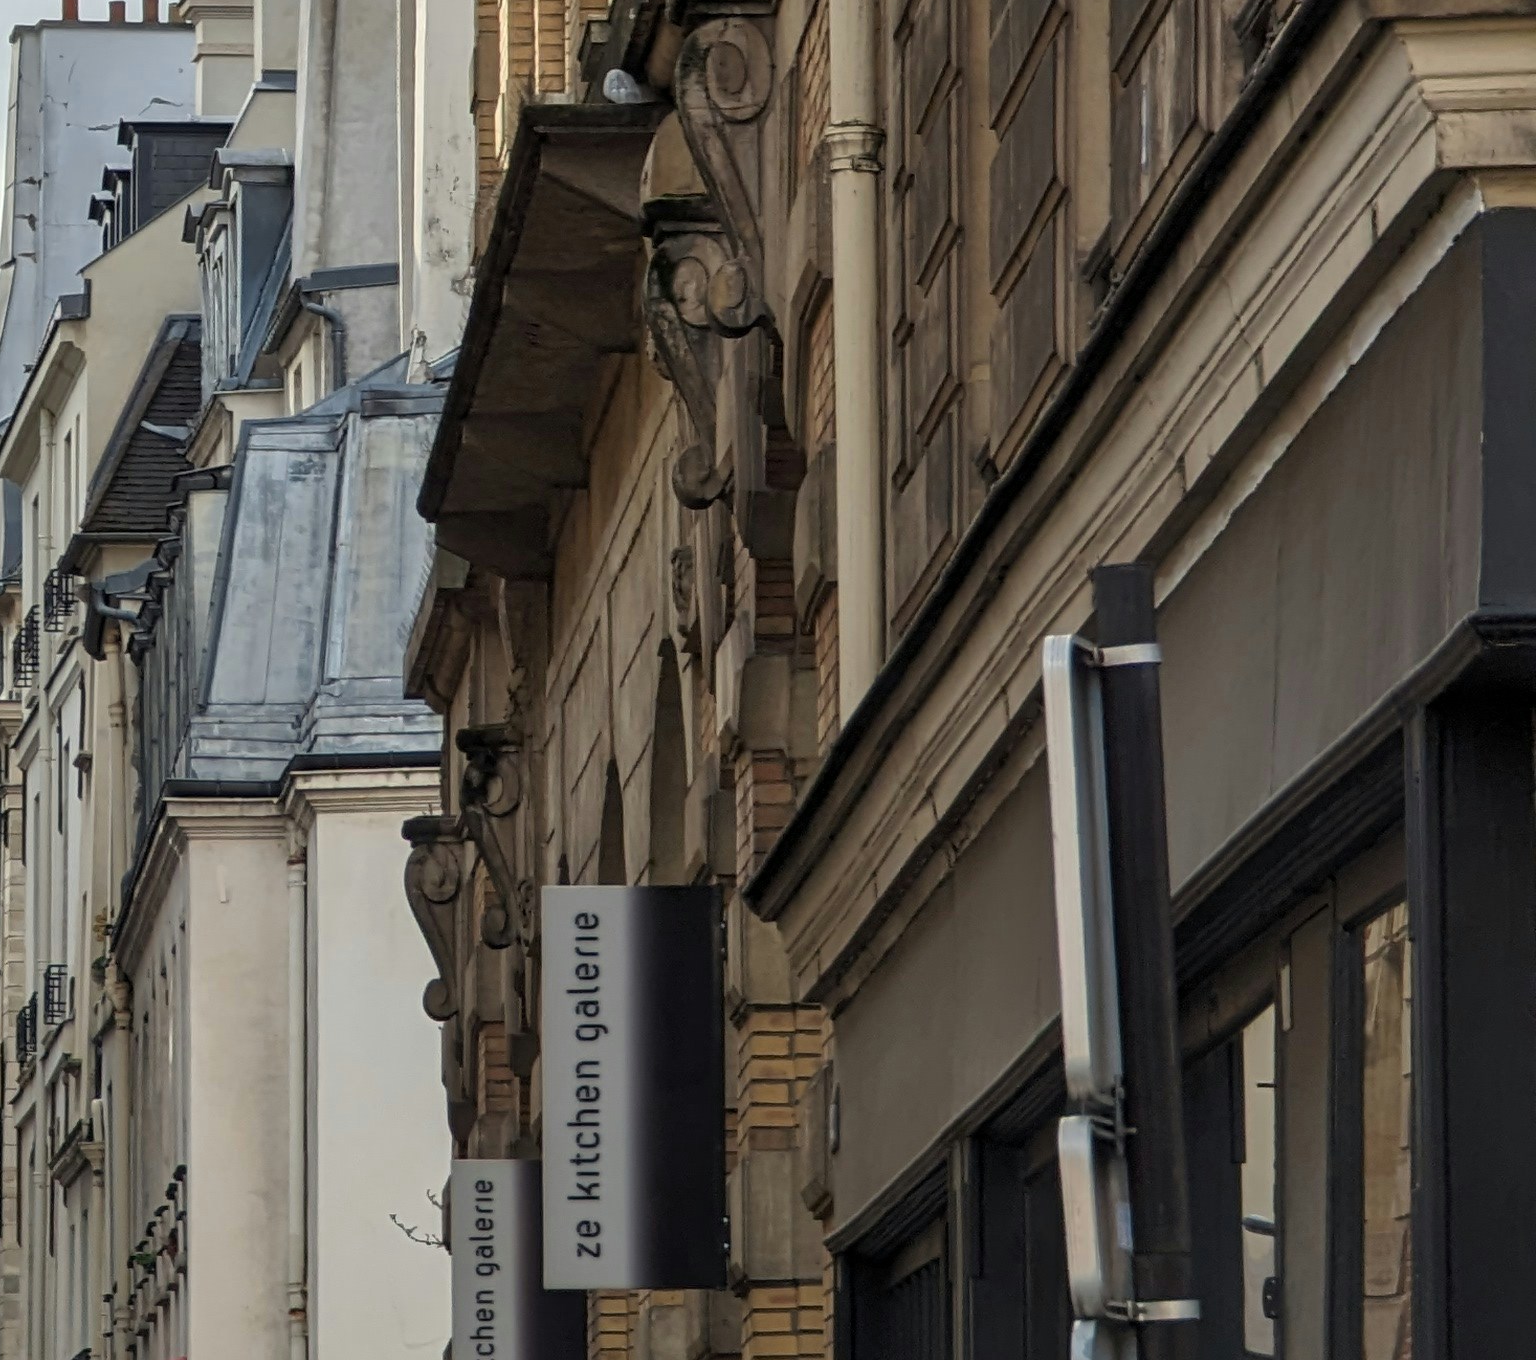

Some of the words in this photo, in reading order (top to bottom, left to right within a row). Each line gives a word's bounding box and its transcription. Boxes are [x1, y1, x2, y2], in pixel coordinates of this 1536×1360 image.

[567, 912, 609, 1042] galerie
[567, 1061, 601, 1202] kitchen
[470, 1179, 501, 1277] galerie
[576, 1220, 601, 1259] ze
